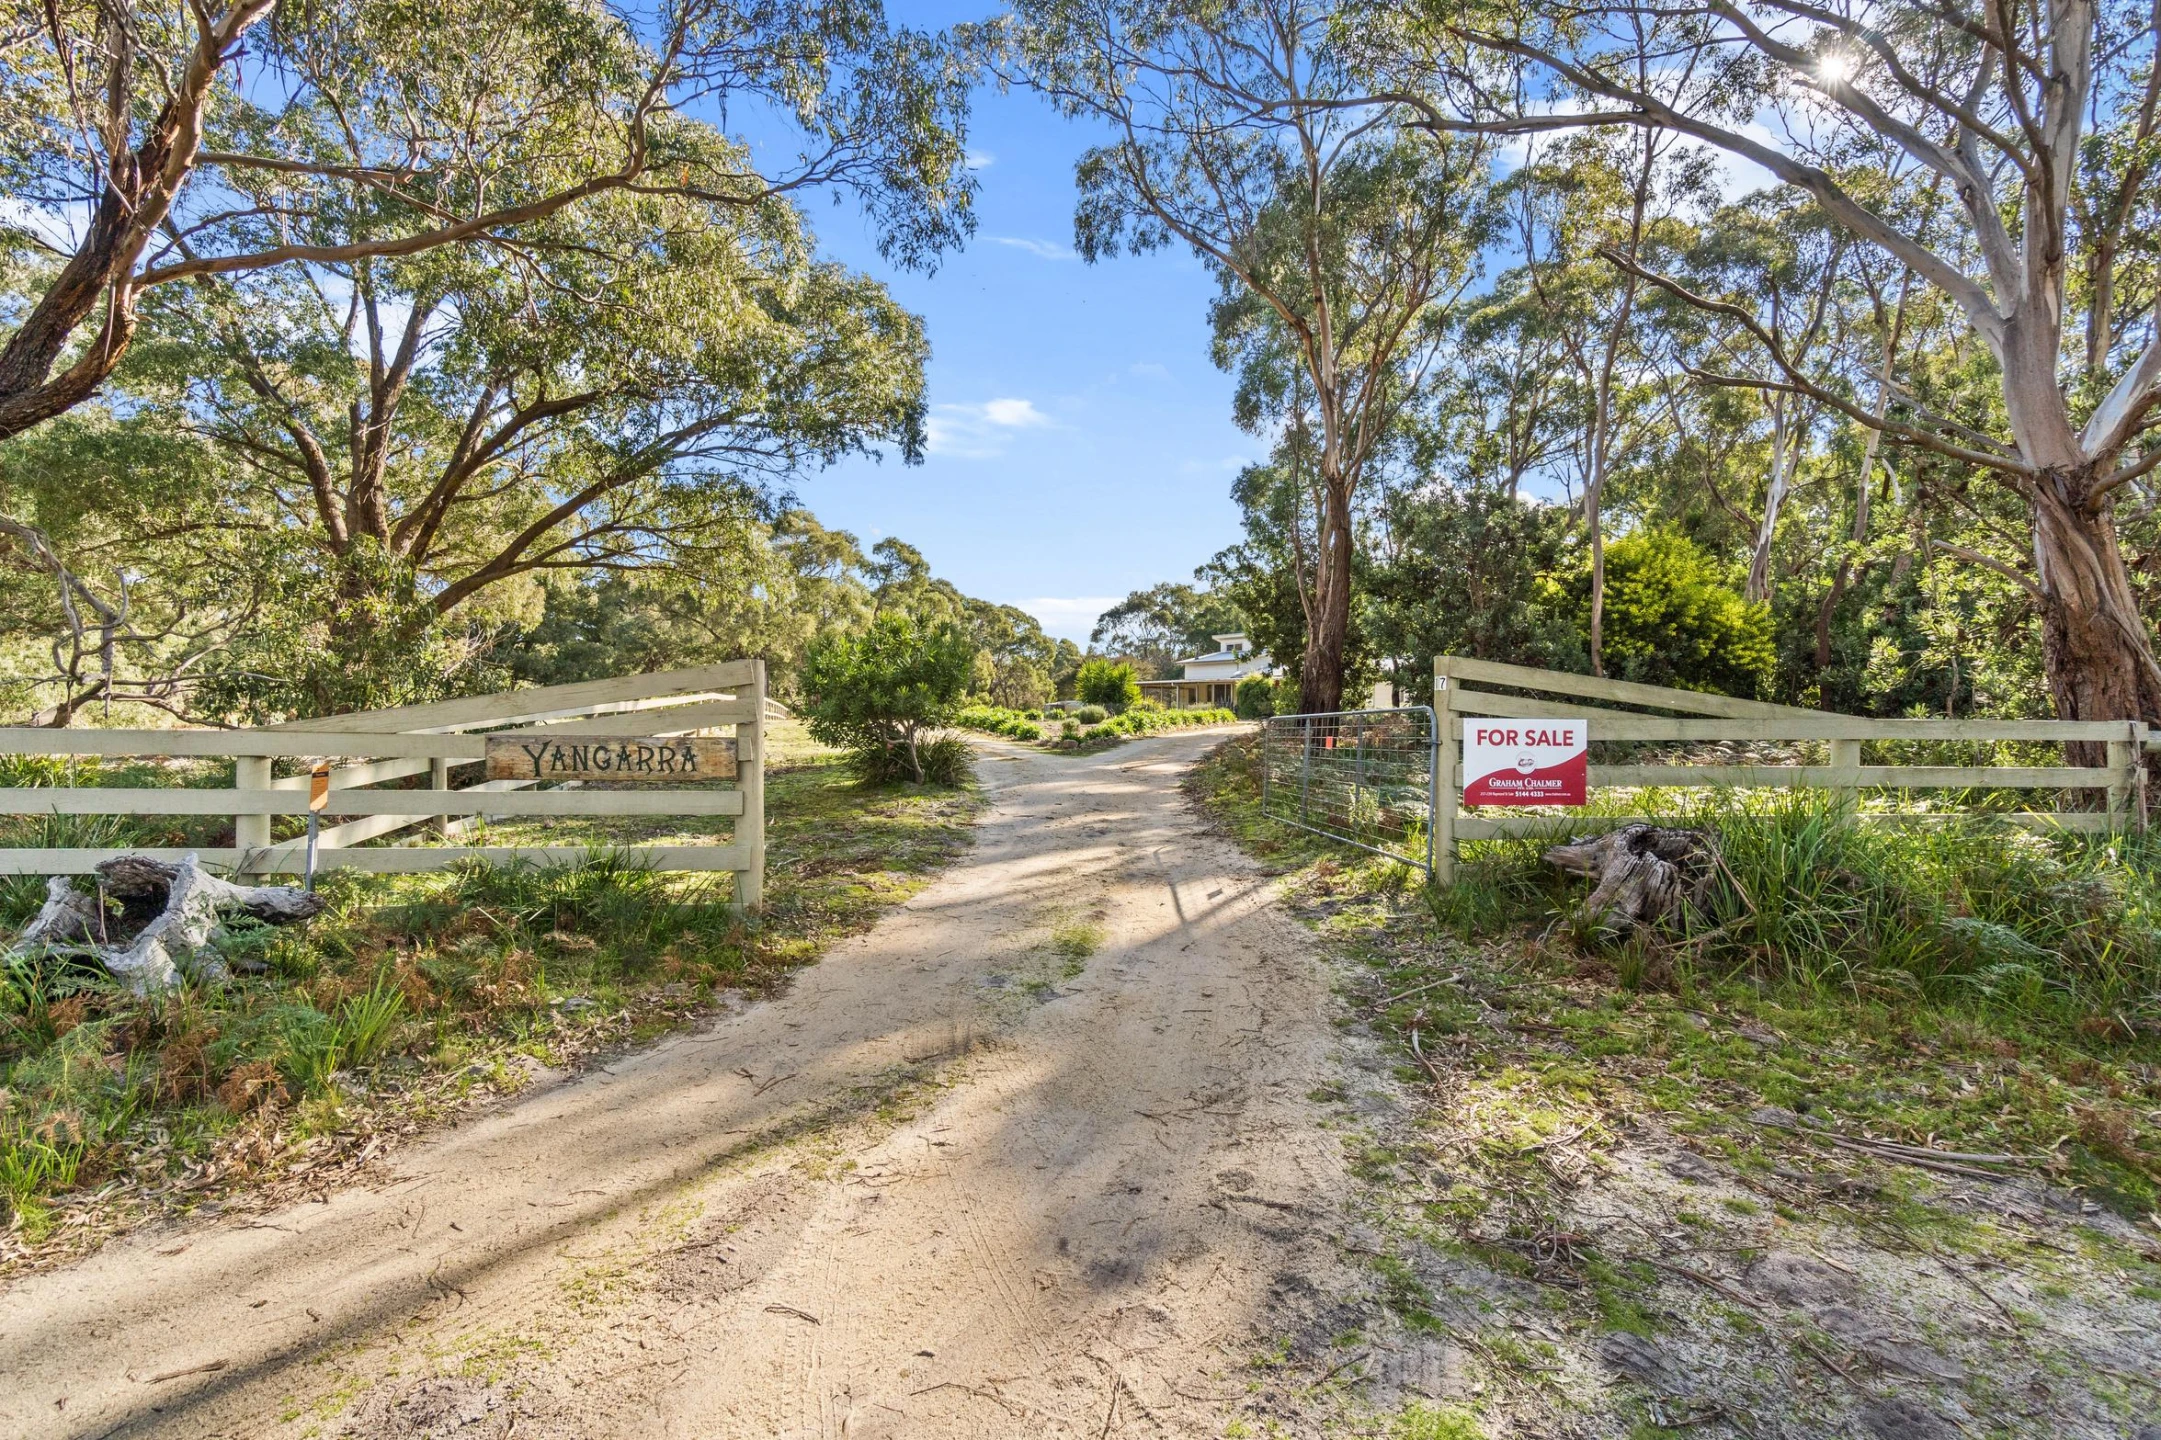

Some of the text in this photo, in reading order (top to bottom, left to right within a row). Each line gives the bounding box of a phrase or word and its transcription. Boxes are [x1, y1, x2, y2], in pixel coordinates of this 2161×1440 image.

[1477, 729, 1574, 747] FOR SALE
[521, 739, 698, 777] YANGARRA
[1489, 777, 1562, 788] GRAHAM CHALMER
